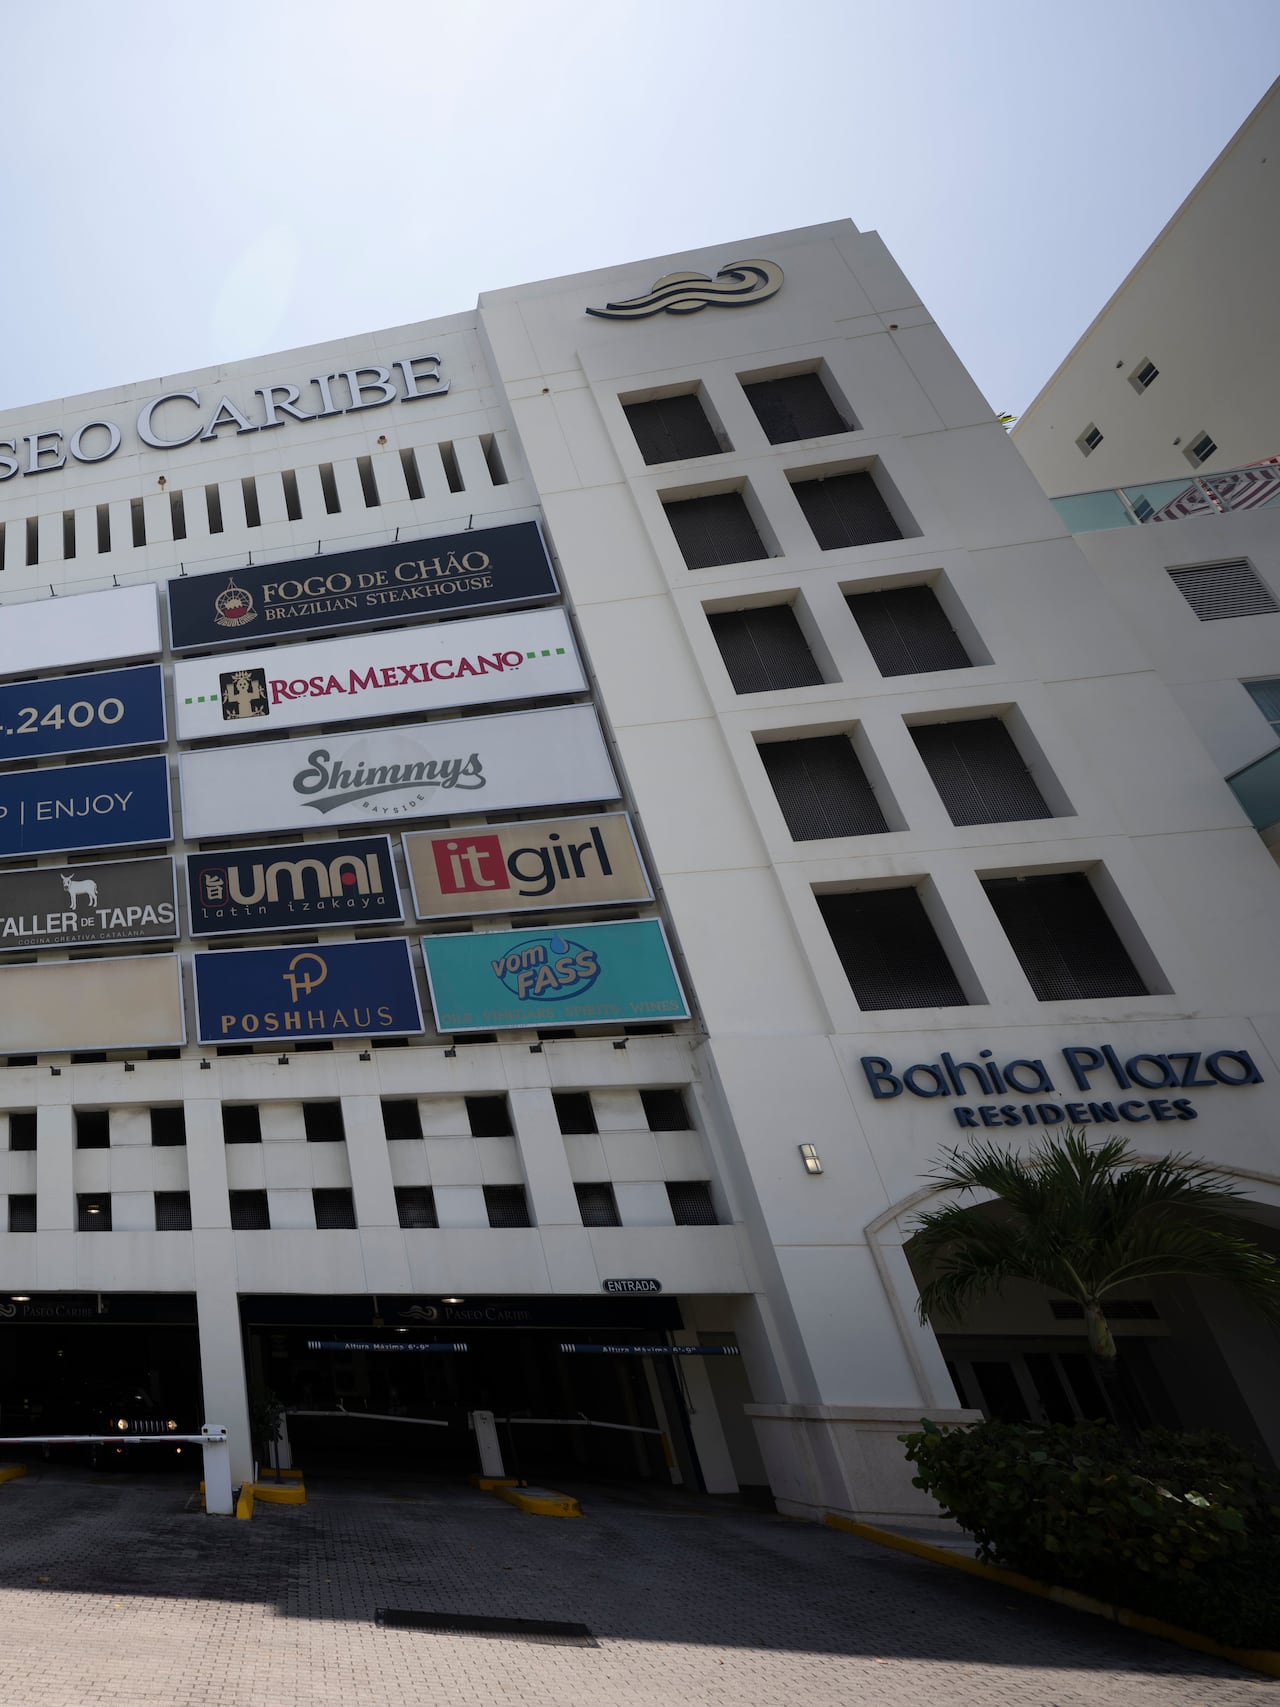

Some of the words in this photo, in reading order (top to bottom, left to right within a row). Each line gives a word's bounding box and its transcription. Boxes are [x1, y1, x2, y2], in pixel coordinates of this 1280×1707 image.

[136, 352, 452, 450] CARIBE
[262, 572, 352, 604] FOGO
[358, 570, 389, 587] DE
[395, 550, 491, 583] CHÃO
[265, 597, 359, 622] BRAZILIAN
[366, 575, 494, 606] STEAKHOUSE
[269, 676, 347, 706] ROSA
[348, 650, 524, 696] MEXICANO
[293, 748, 487, 795] Shimmys
[36, 791, 134, 822] ENJOY
[362, 794, 425, 814] BAYSIDE
[447, 842, 495, 889] it
[507, 826, 613, 897] girl
[80, 917, 95, 928] DE
[96, 902, 175, 930] TAPAS
[202, 904, 268, 919] latin
[288, 896, 386, 912] izakaya
[18, 937, 51, 946] COCINA
[55, 933, 97, 944] CREATIVA
[100, 929, 145, 940] CATALANA
[491, 945, 547, 978] vom
[517, 950, 601, 1000] FASS
[222, 1005, 393, 1034] POSHHAUS
[630, 1000, 680, 1013] WINES
[860, 1049, 1055, 1100] Bahia
[1062, 1044, 1265, 1092] Plaza
[953, 1098, 1199, 1128] RESIDENCES
[607, 1279, 658, 1292] ENTRADA
